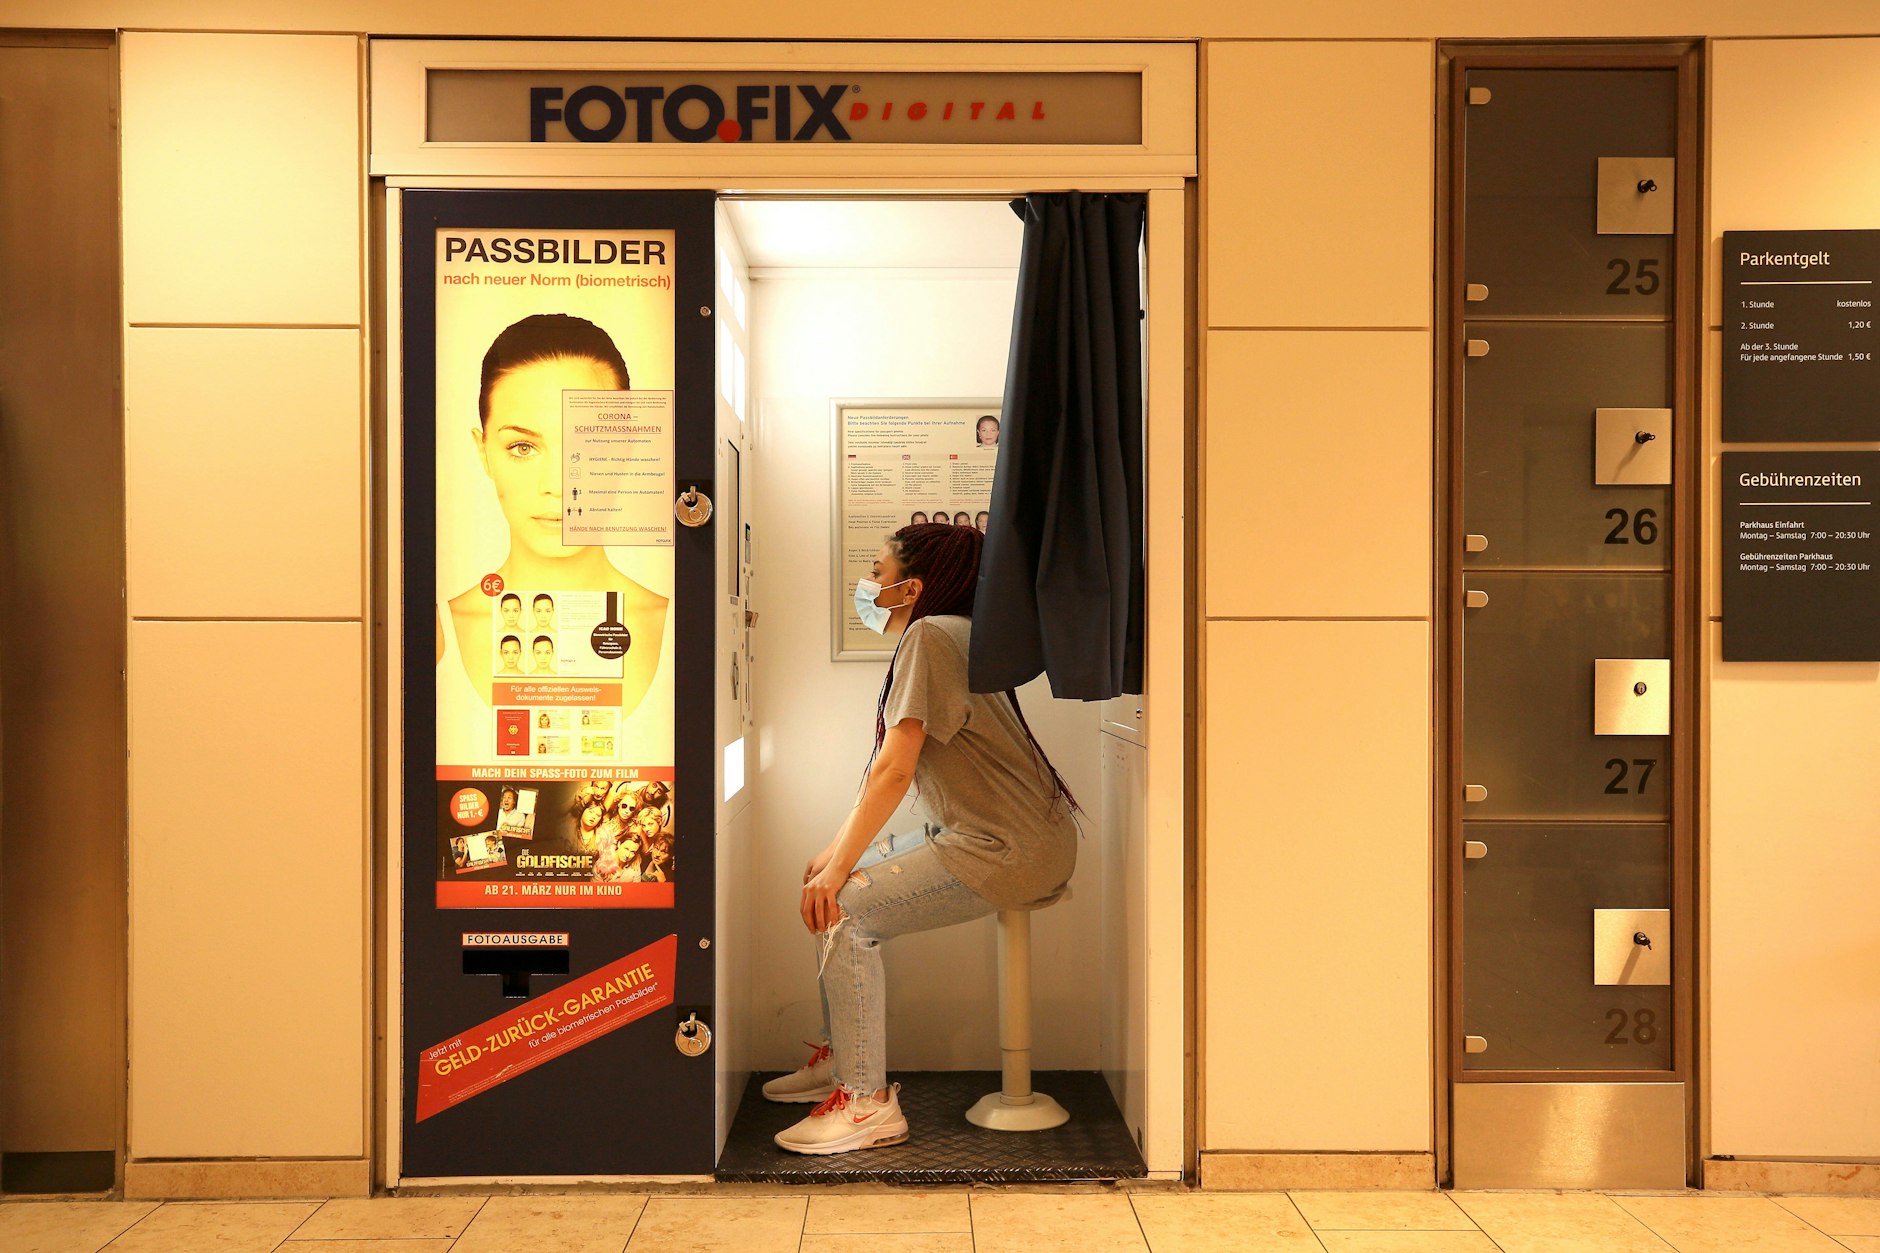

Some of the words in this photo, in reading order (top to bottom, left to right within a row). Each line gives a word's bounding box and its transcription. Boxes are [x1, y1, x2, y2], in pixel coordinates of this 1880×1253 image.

[849, 101, 1046, 121] DIGITAL
[445, 237, 666, 265] PASSBILDER
[1740, 251, 1830, 269] Parkentgelt
[443, 273, 480, 285] nach
[484, 275, 526, 286] neuer
[530, 274, 571, 286] Norm
[576, 273, 671, 290] (biometrisch)
[1605, 258, 1660, 296] 25
[1848, 321, 1865, 330] 1,20
[1740, 343, 1751, 351] Ab
[1740, 353, 1752, 361] Für
[1752, 353, 1769, 362] jede
[1770, 353, 1817, 362] angefangene
[1848, 353, 1865, 361] 1,50
[574, 425, 662, 433] SCHUTZMASSNAHMEN
[1739, 472, 1861, 487] Gebührenzeiten
[1603, 508, 1659, 545] 26
[1740, 521, 1774, 529] Parkhaus
[1775, 521, 1805, 529] Einfahrt
[1740, 532, 1768, 540] Montag
[1775, 532, 1807, 540] Samstag
[1740, 553, 1798, 561] Gebührenzeiten
[1740, 564, 1768, 572] Montag
[1775, 563, 1807, 572] Samstag
[1810, 563, 1827, 571] 7:00
[483, 578, 501, 592] 6€
[510, 685, 523, 693] Für
[555, 694, 596, 702] zugelassen!
[471, 768, 501, 778] MACH
[504, 768, 527, 778] DEIN
[529, 768, 587, 778] SPASS-FOTO
[590, 769, 613, 779] ZUM
[615, 769, 639, 779] FILM
[1604, 758, 1658, 795] 27
[459, 794, 478, 803] SPASS
[459, 801, 480, 811] BILDER
[457, 811, 470, 819] NUR
[521, 848, 529, 856] DIE
[516, 855, 593, 869] GOLDFISCHE
[484, 885, 499, 895] AB
[501, 885, 518, 895] 21.
[521, 883, 551, 895] MÄRZ
[555, 885, 577, 895] NUR
[579, 885, 594, 895] IM
[596, 885, 622, 896] KINO
[467, 934, 563, 945] FOTOAUSGABE
[434, 963, 655, 1076] GELD-ZURÜCK-GARANTIE
[528, 1037, 541, 1049] für
[540, 1030, 557, 1044] alle
[557, 1003, 616, 1036] biometrischen
[1604, 1008, 1658, 1045] 28
[428, 1043, 448, 1060] Jetzt
[447, 1039, 462, 1053] mit
